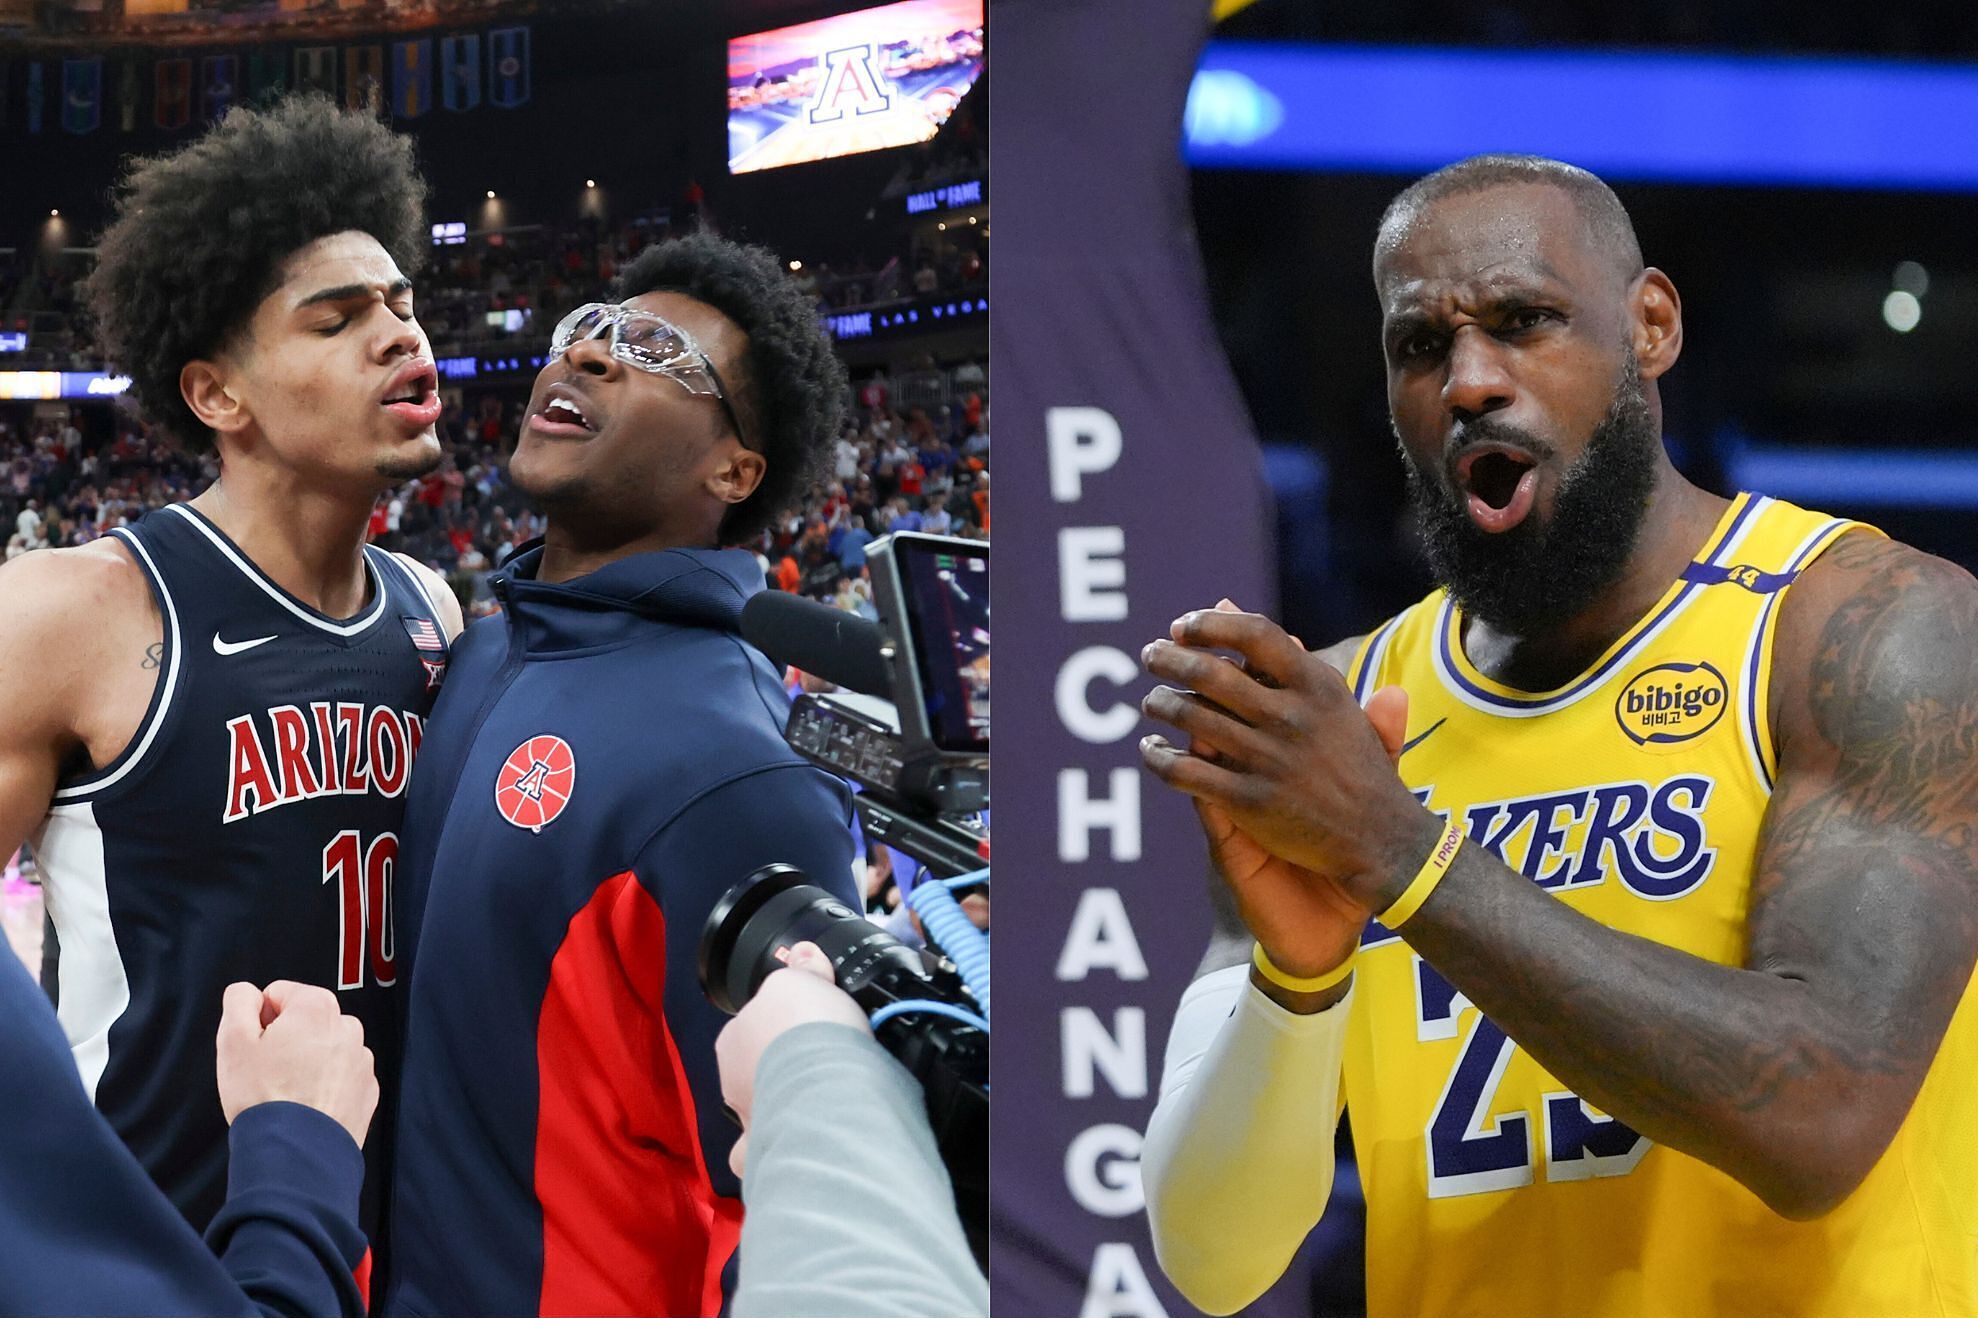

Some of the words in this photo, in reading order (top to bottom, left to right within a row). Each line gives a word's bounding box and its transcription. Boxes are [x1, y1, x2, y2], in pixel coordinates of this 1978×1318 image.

[810, 44, 889, 124] A
[880, 312, 920, 328] LAS
[1626, 683, 1721, 717] bibigo
[1641, 711, 1681, 727] 비비고
[514, 760, 550, 802] A
[1046, 406, 1170, 1318] PECHANGA
[1404, 773, 1718, 905] KERS
[322, 829, 400, 991] 10
